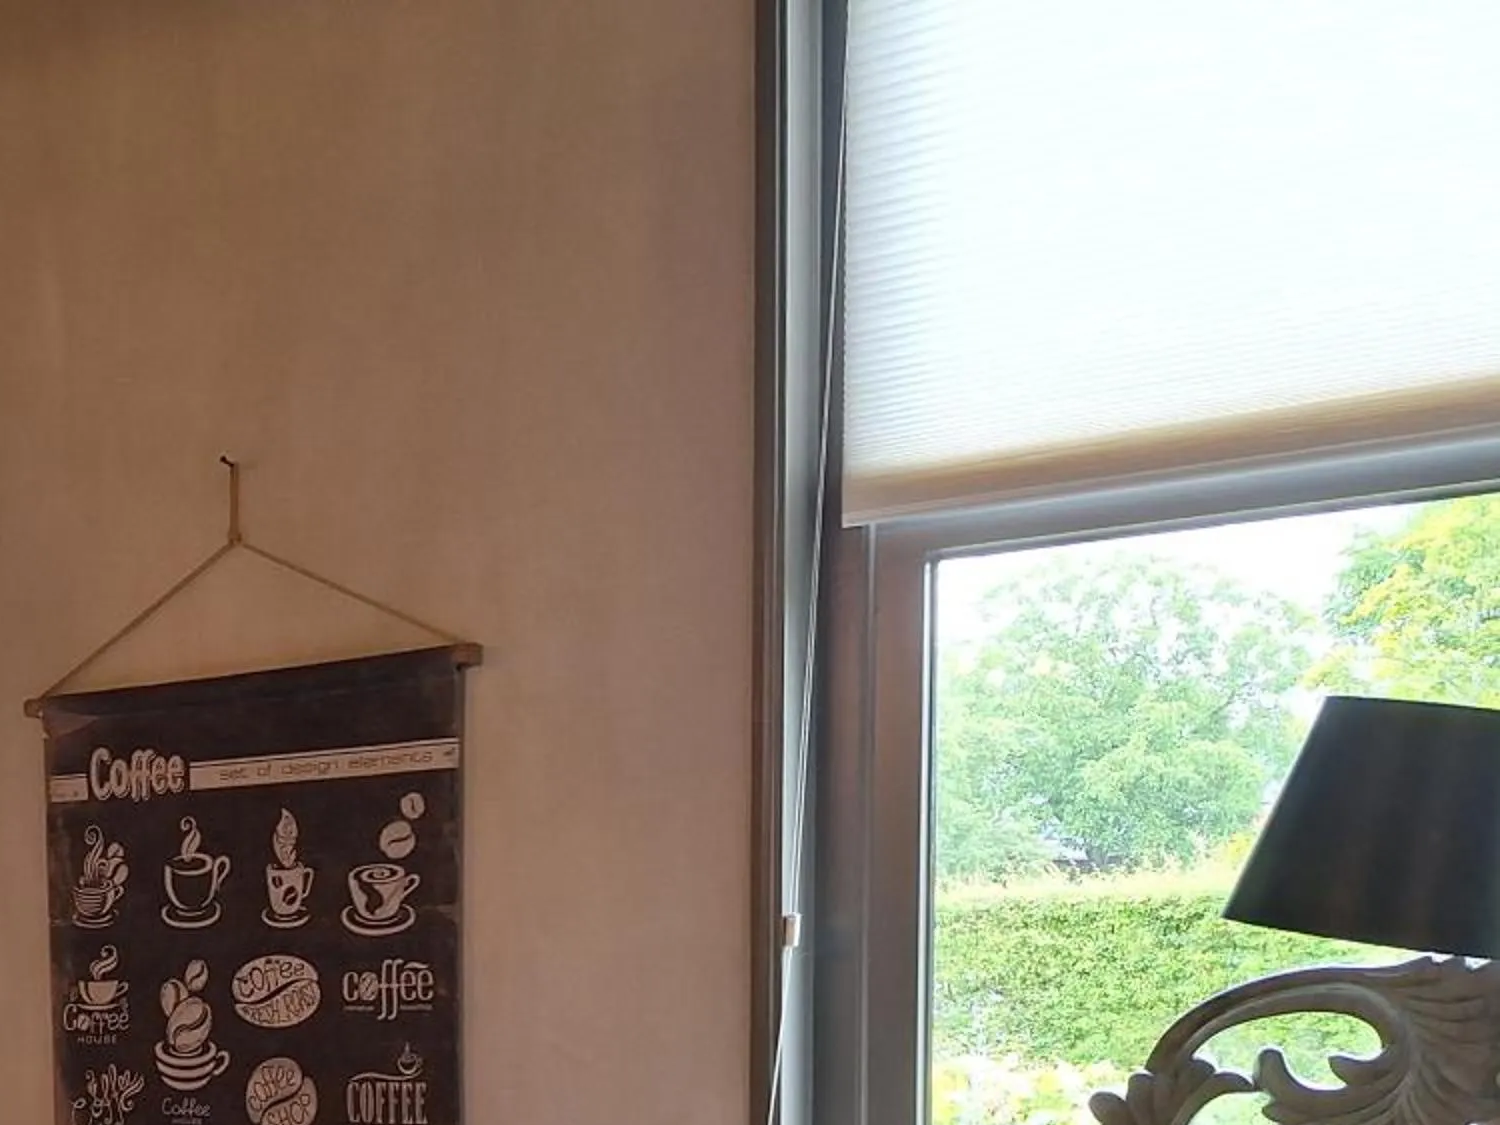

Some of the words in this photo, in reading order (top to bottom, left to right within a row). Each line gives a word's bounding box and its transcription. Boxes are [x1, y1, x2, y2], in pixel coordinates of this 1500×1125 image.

[90, 747, 187, 801] Coffee
[343, 959, 434, 1020] coffee
[63, 1002, 130, 1035] Coffee
[346, 1081, 429, 1125] COFFEE
